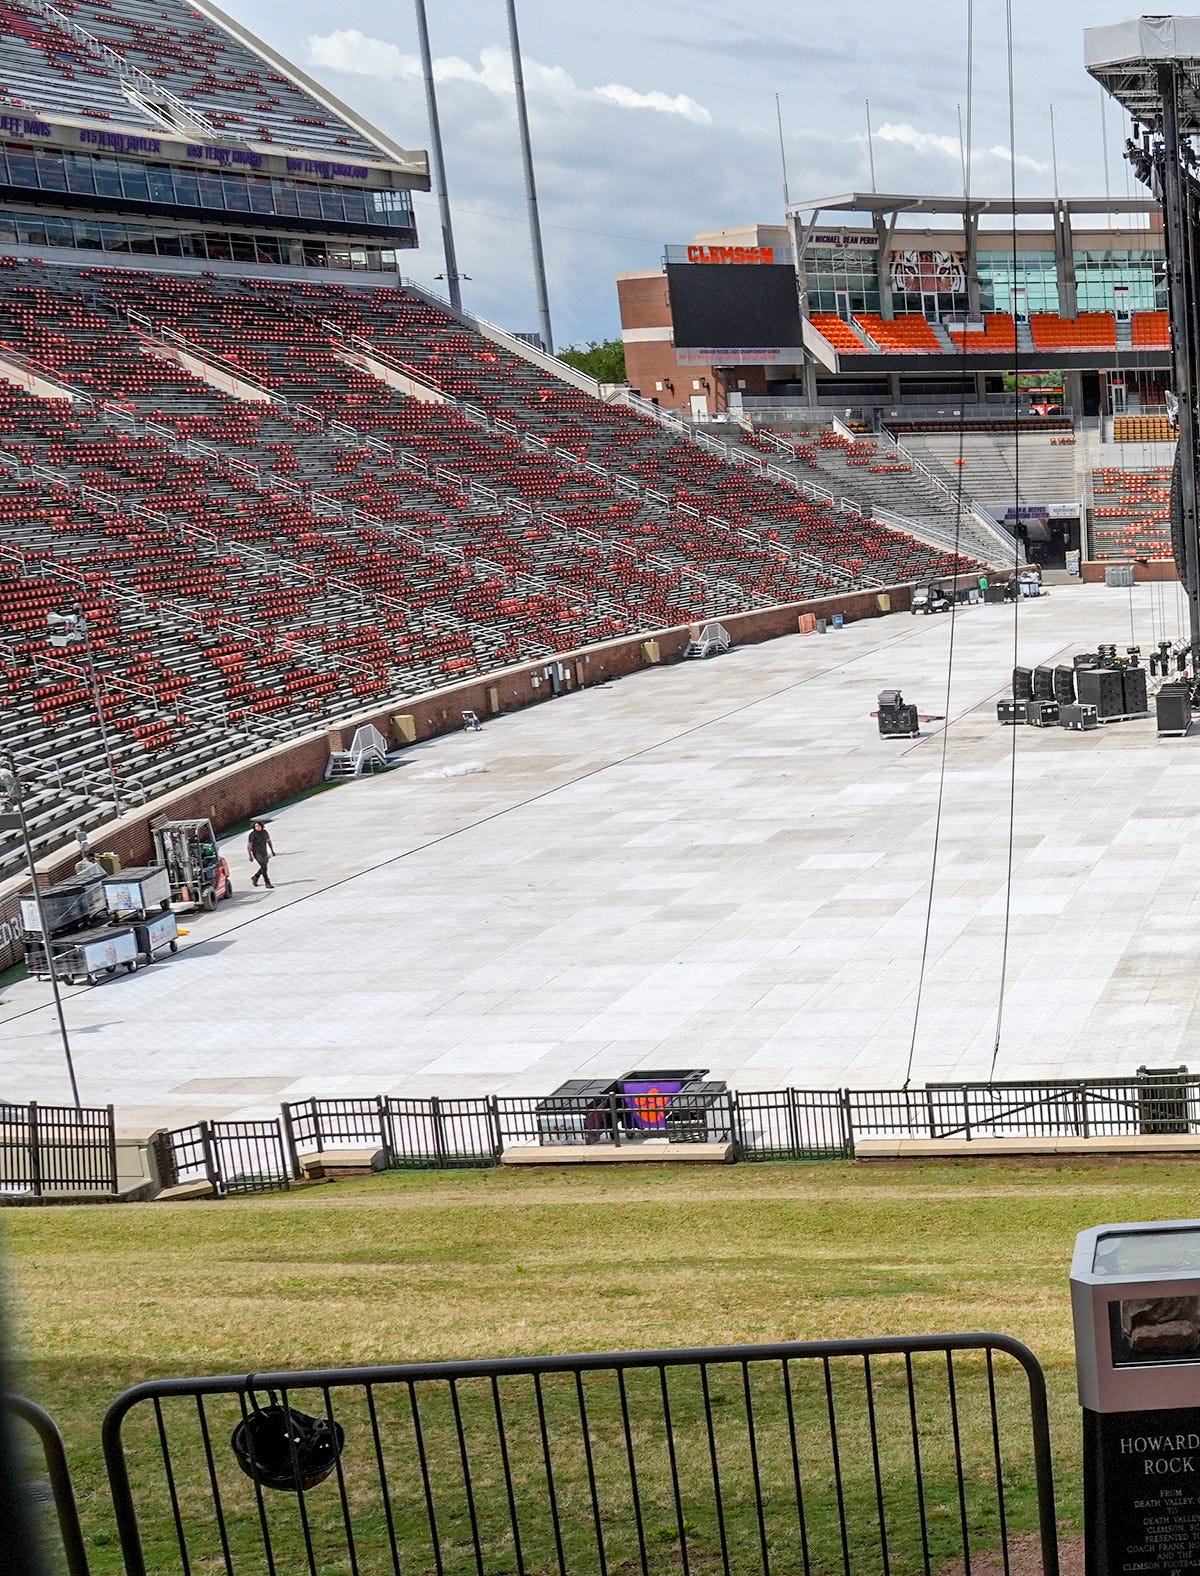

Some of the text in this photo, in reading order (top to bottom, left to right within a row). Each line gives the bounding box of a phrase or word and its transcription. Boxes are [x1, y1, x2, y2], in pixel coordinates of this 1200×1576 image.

[24, 120, 52, 138] DAVIS
[815, 235, 841, 244] MICHAEL
[842, 236, 859, 244] DEAN
[859, 236, 879, 245] PERRY
[687, 245, 774, 263] CLEMSON
[1144, 1456, 1195, 1475] ROCK
[1159, 1489, 1183, 1498] FROM
[1134, 1499, 1161, 1508] DEATH
[1166, 1507, 1178, 1515] TO
[1143, 1516, 1170, 1525] DEATH
[1189, 1523, 1200, 1531] SC
[1145, 1533, 1189, 1543] PRESENTED
[1126, 1544, 1155, 1553] COACH
[1158, 1542, 1185, 1551] FRANK
[1156, 1550, 1193, 1560] AND THE
[1122, 1561, 1160, 1571] CLEMSON
